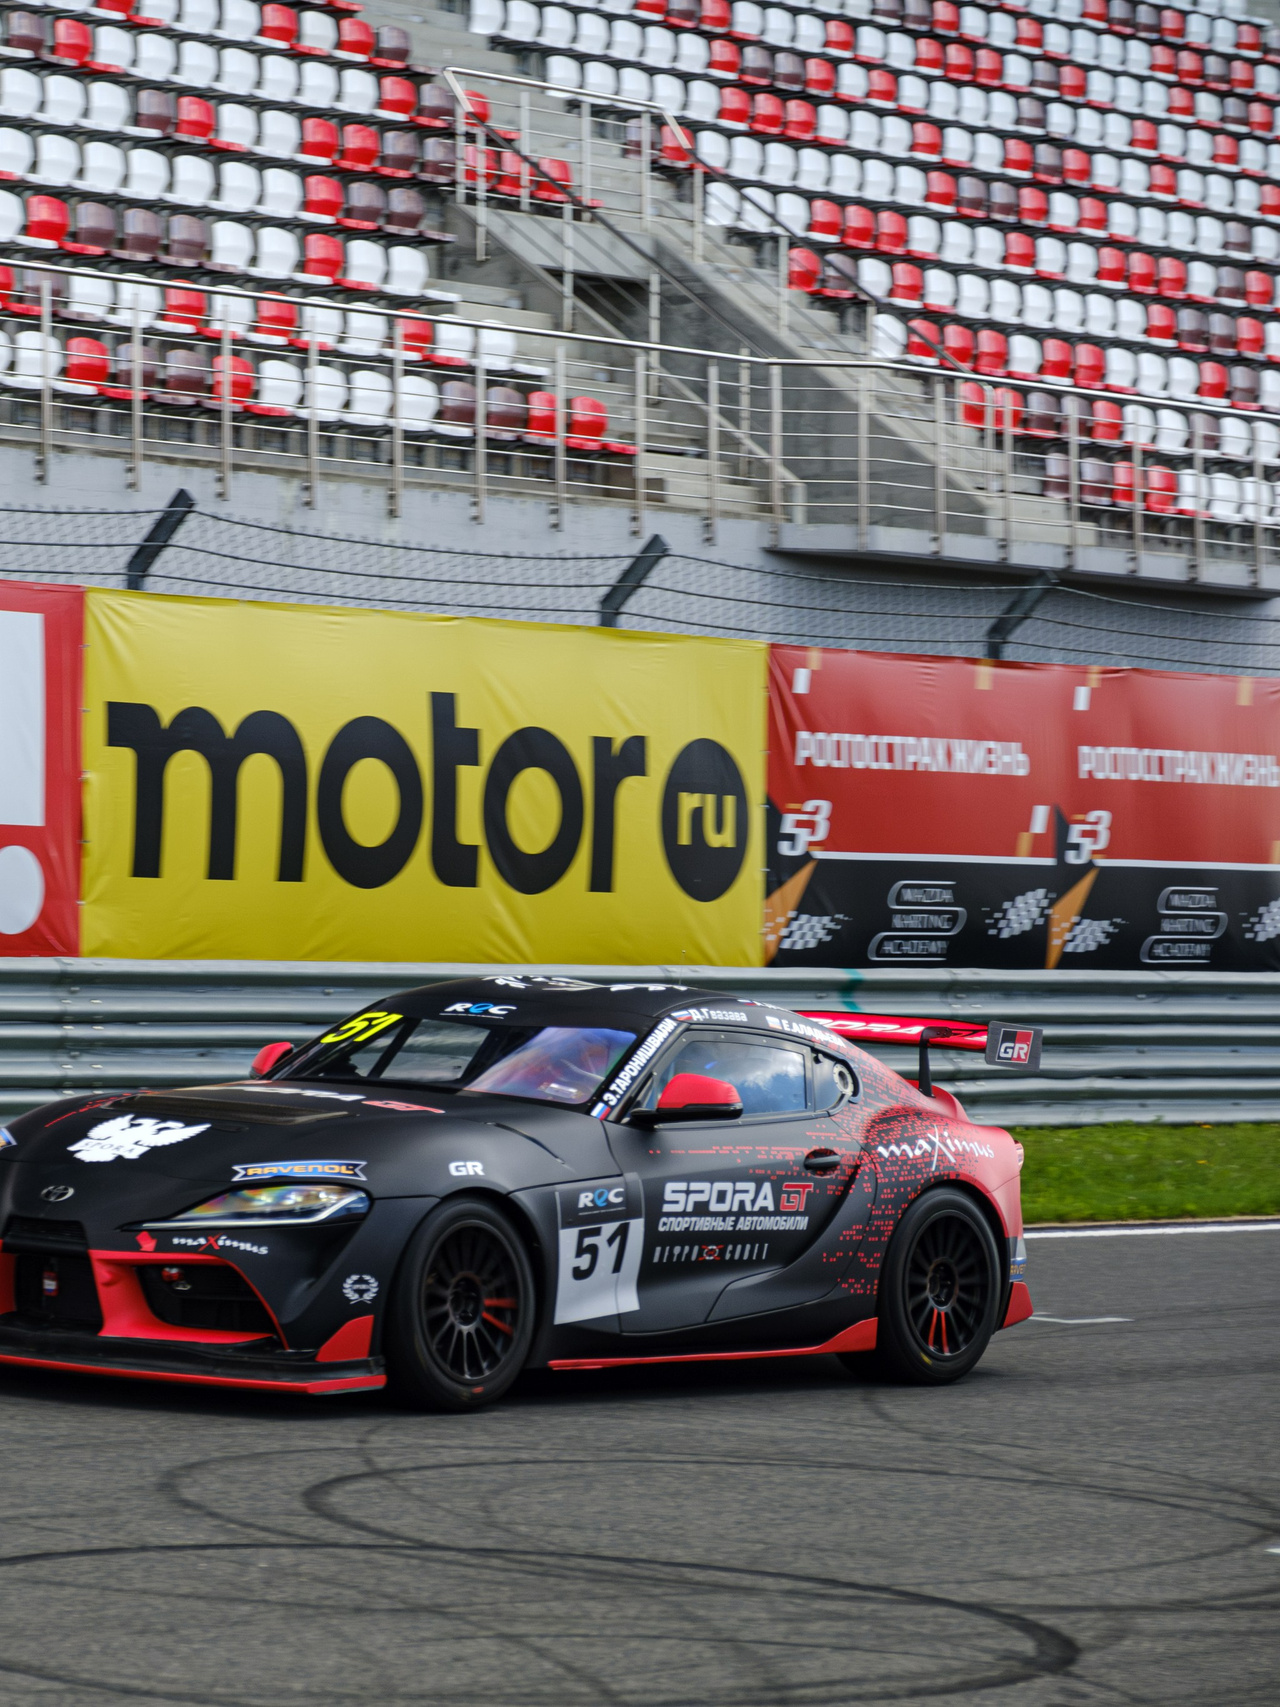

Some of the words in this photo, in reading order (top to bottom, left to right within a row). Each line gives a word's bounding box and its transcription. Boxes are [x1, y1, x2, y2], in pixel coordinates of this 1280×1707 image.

[106, 690, 649, 895] motor
[320, 1011, 405, 1044] 51
[998, 1041, 1030, 1059] GR
[79, 1141, 136, 1154] SPORA
[246, 1164, 355, 1176] RAVENOL
[448, 1161, 485, 1176] GR
[662, 1182, 775, 1212] SPORA
[779, 1182, 815, 1212] GT
[658, 1216, 734, 1232] СПОРТИВНЫЕ
[735, 1216, 810, 1232] АВТОМОБИЛИ
[572, 1221, 631, 1281] 51
